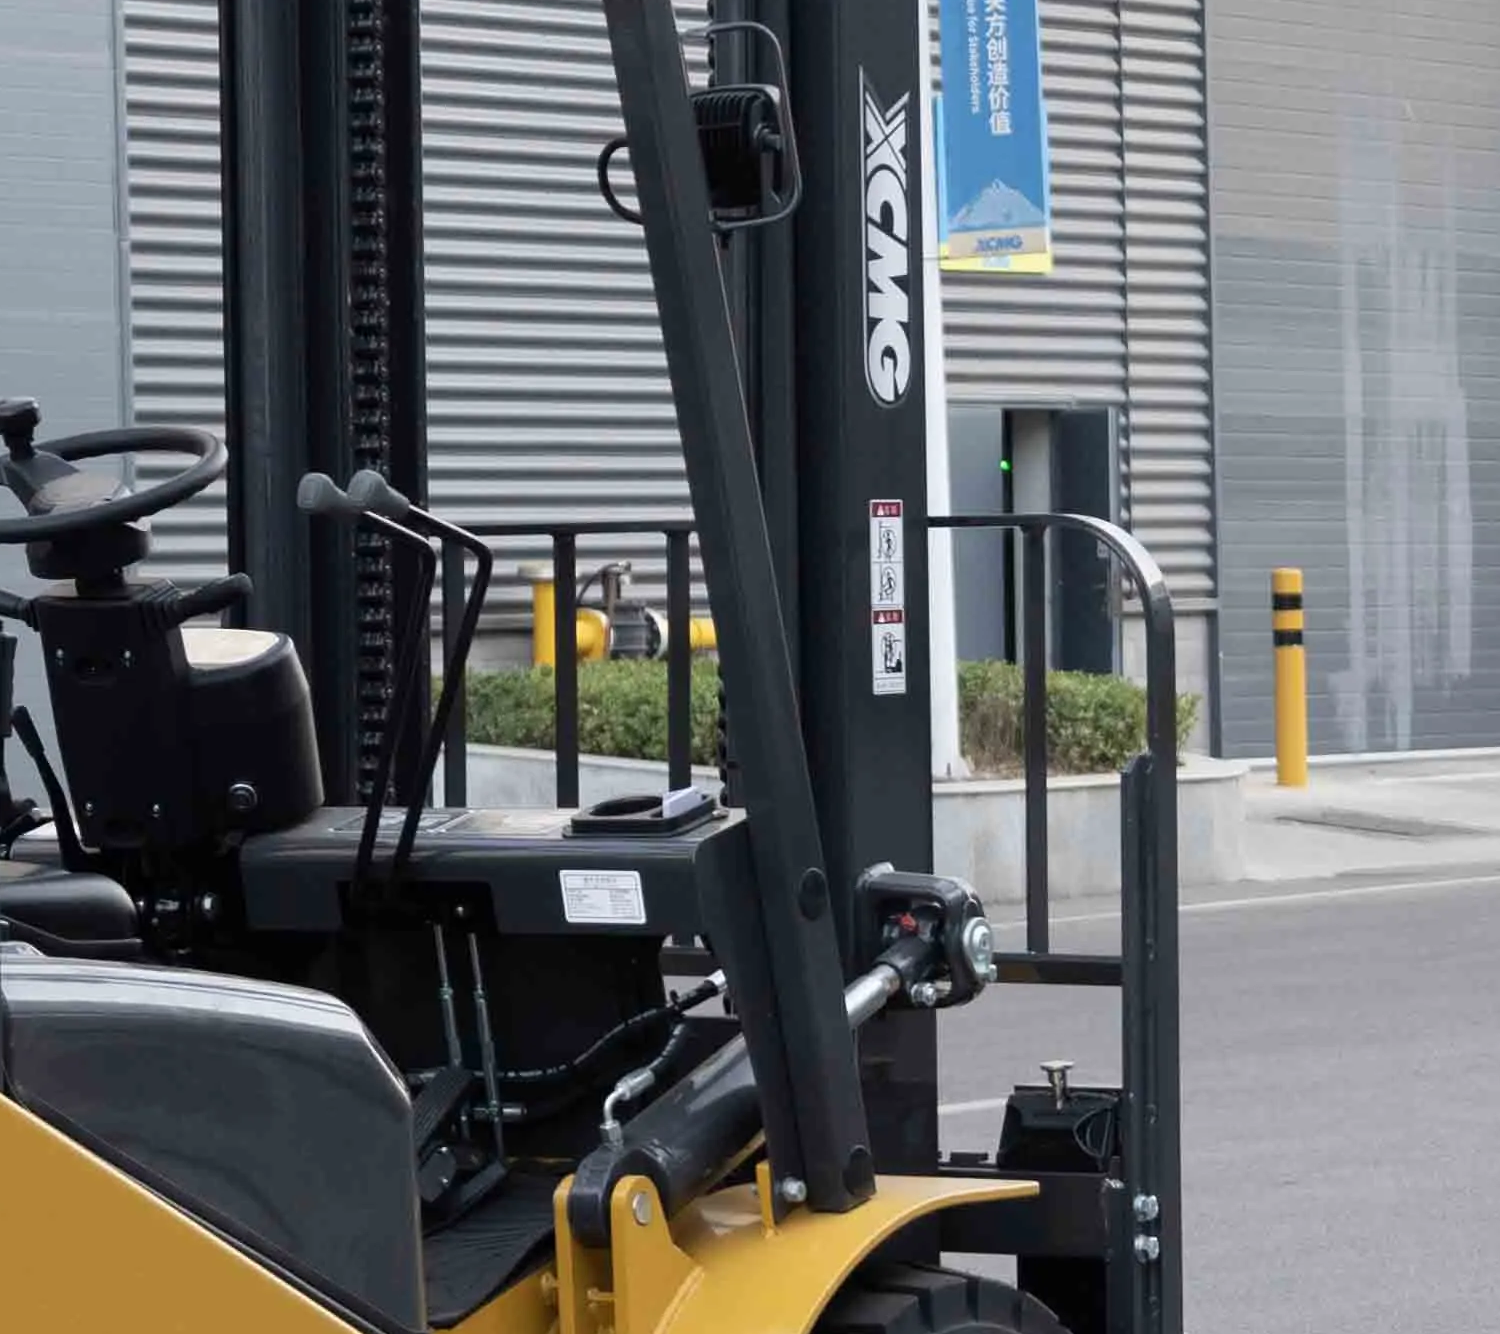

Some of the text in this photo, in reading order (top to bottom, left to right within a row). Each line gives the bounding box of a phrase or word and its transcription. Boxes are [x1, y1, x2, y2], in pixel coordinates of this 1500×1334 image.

[967, 16, 979, 32] for
[967, 36, 981, 114] Stakeholders
[865, 89, 911, 403] XCMG
